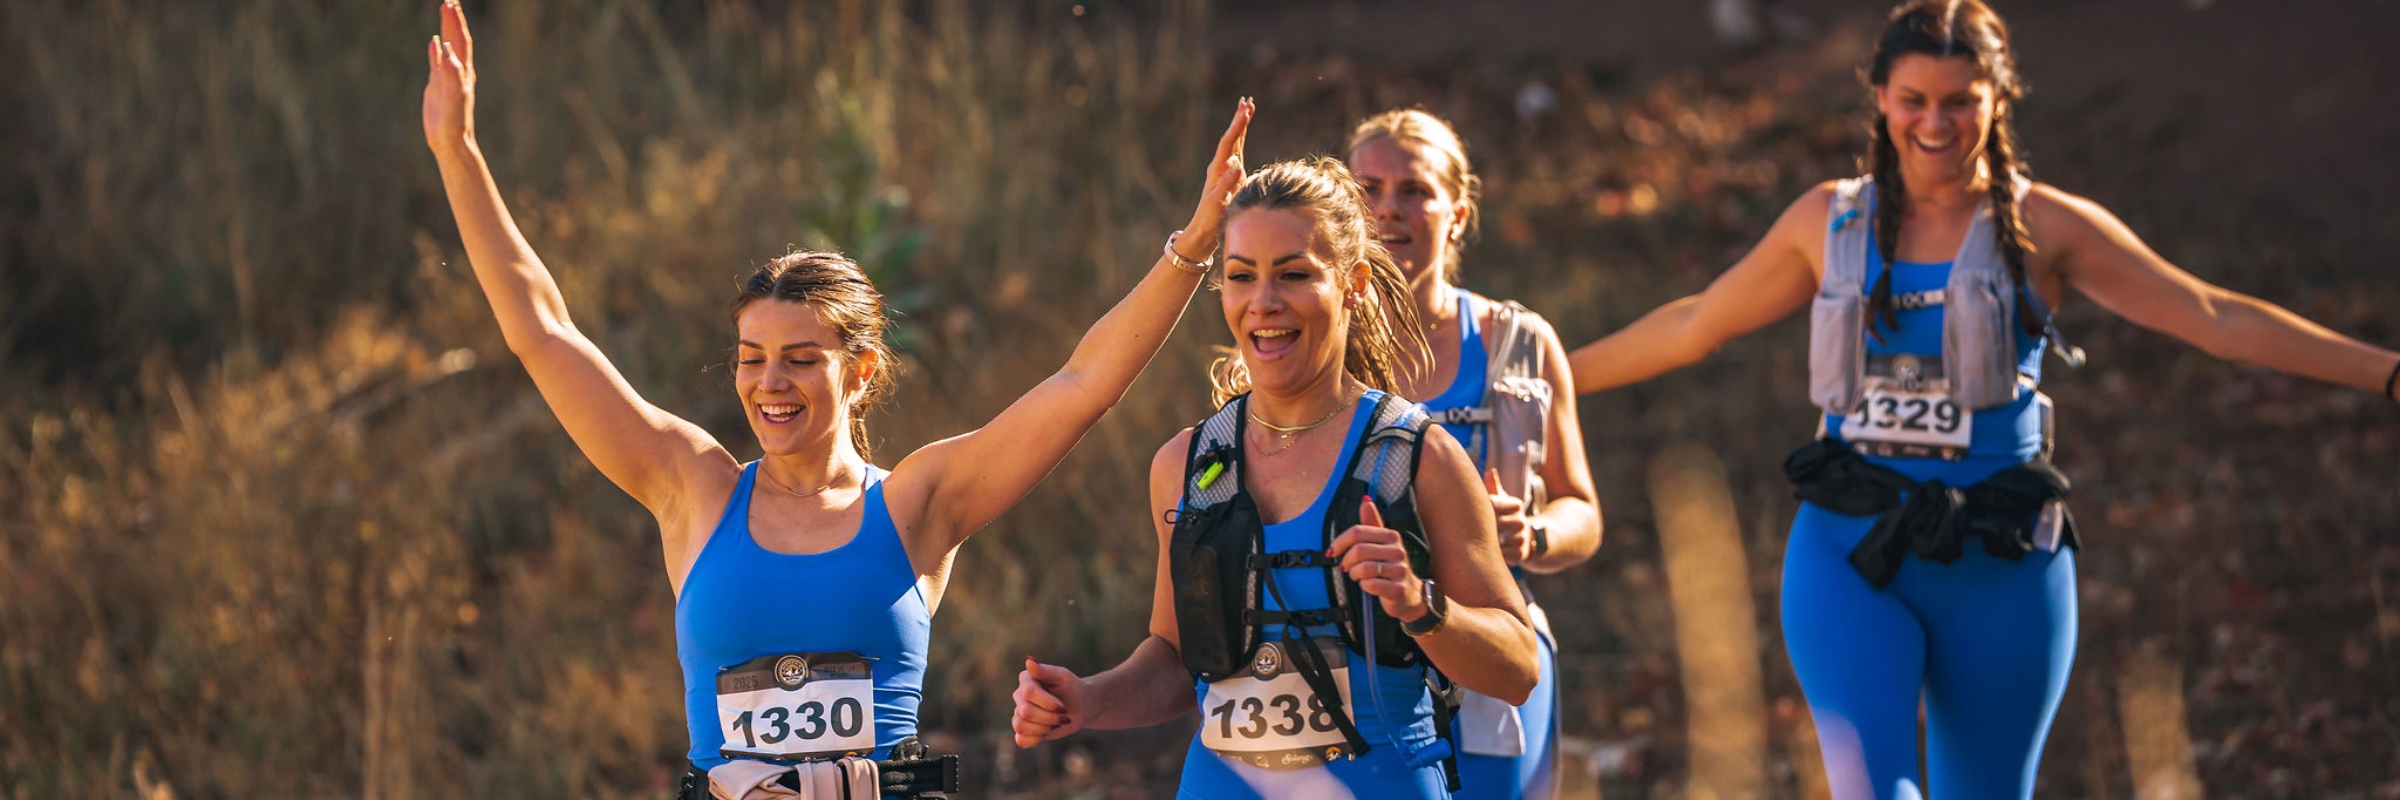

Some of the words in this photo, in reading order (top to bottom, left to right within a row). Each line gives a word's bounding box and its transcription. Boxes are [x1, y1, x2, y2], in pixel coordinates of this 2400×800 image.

[1855, 396, 1961, 433] 1329
[733, 674, 759, 690] 2025
[732, 696, 863, 748] 1330
[1211, 693, 1338, 739] 1338
